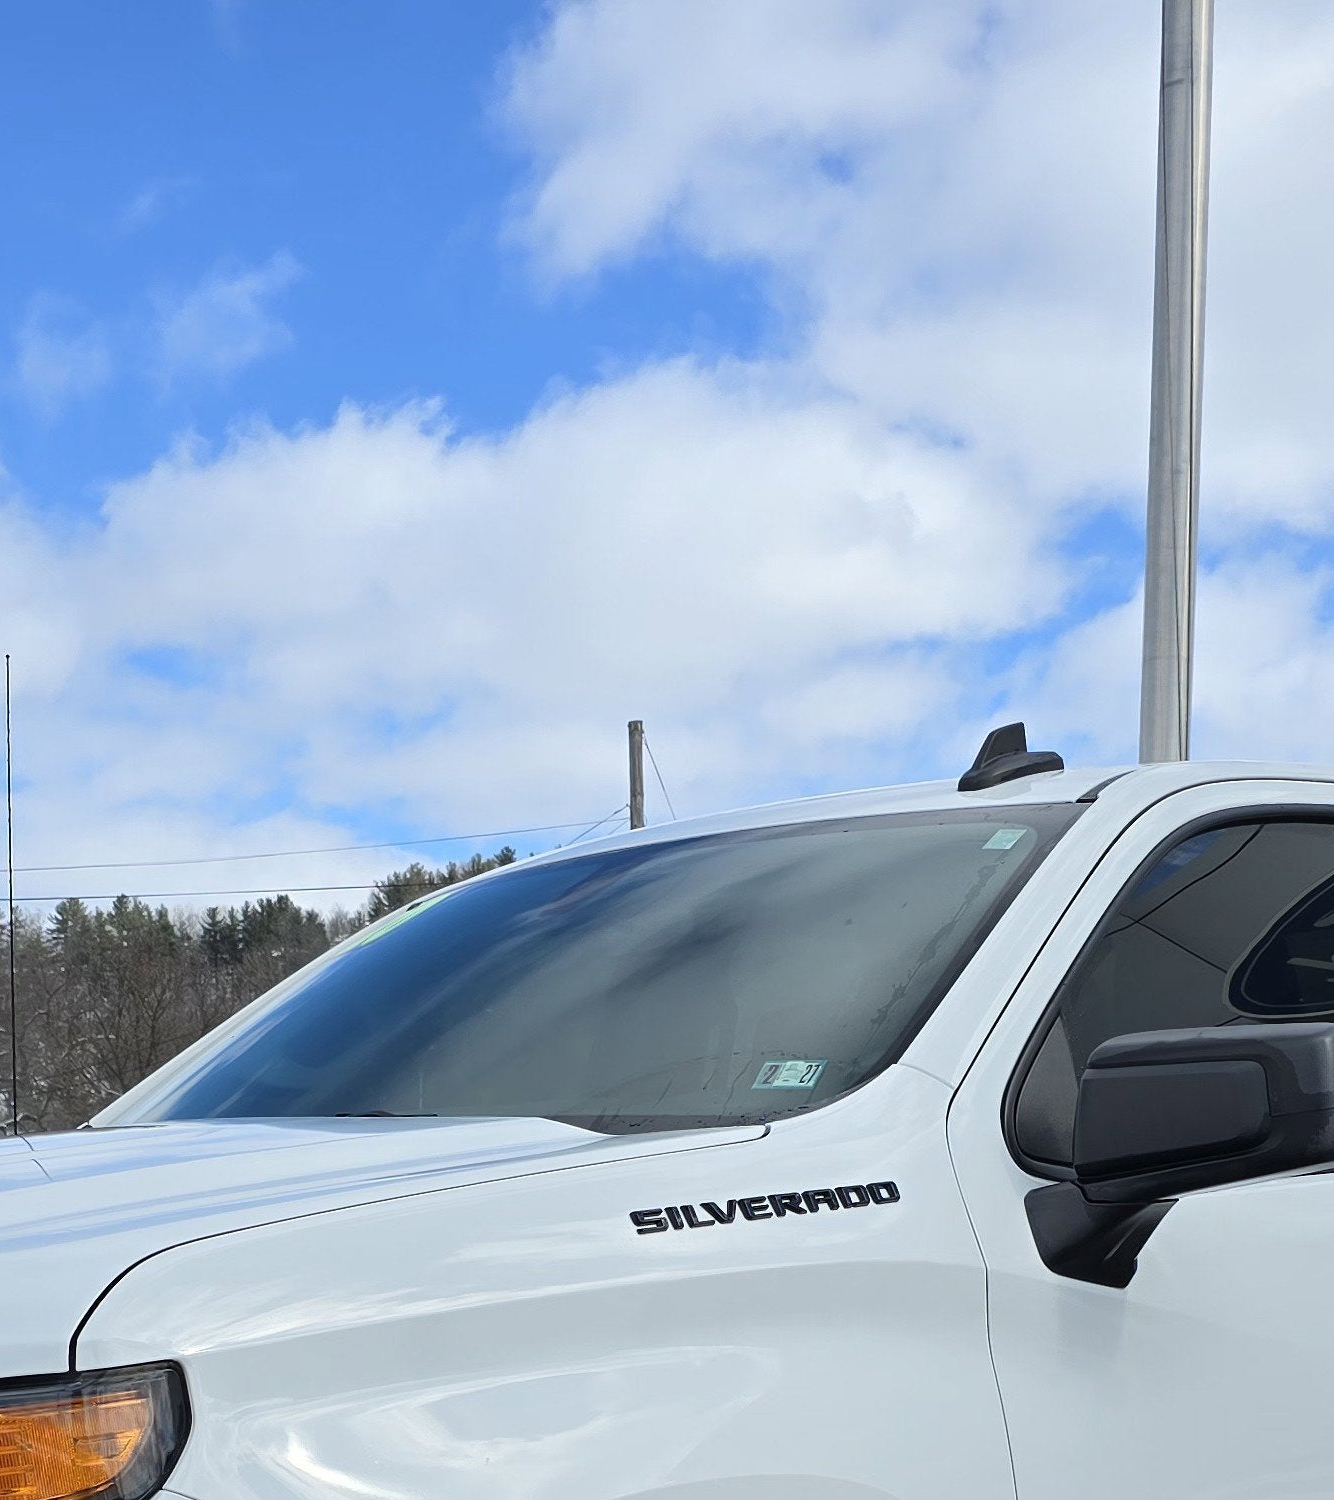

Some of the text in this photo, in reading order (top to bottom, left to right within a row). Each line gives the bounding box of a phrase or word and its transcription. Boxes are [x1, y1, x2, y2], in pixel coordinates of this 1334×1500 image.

[762, 1064, 821, 1085] 2 27
[629, 1180, 901, 1235] SILVERADO
